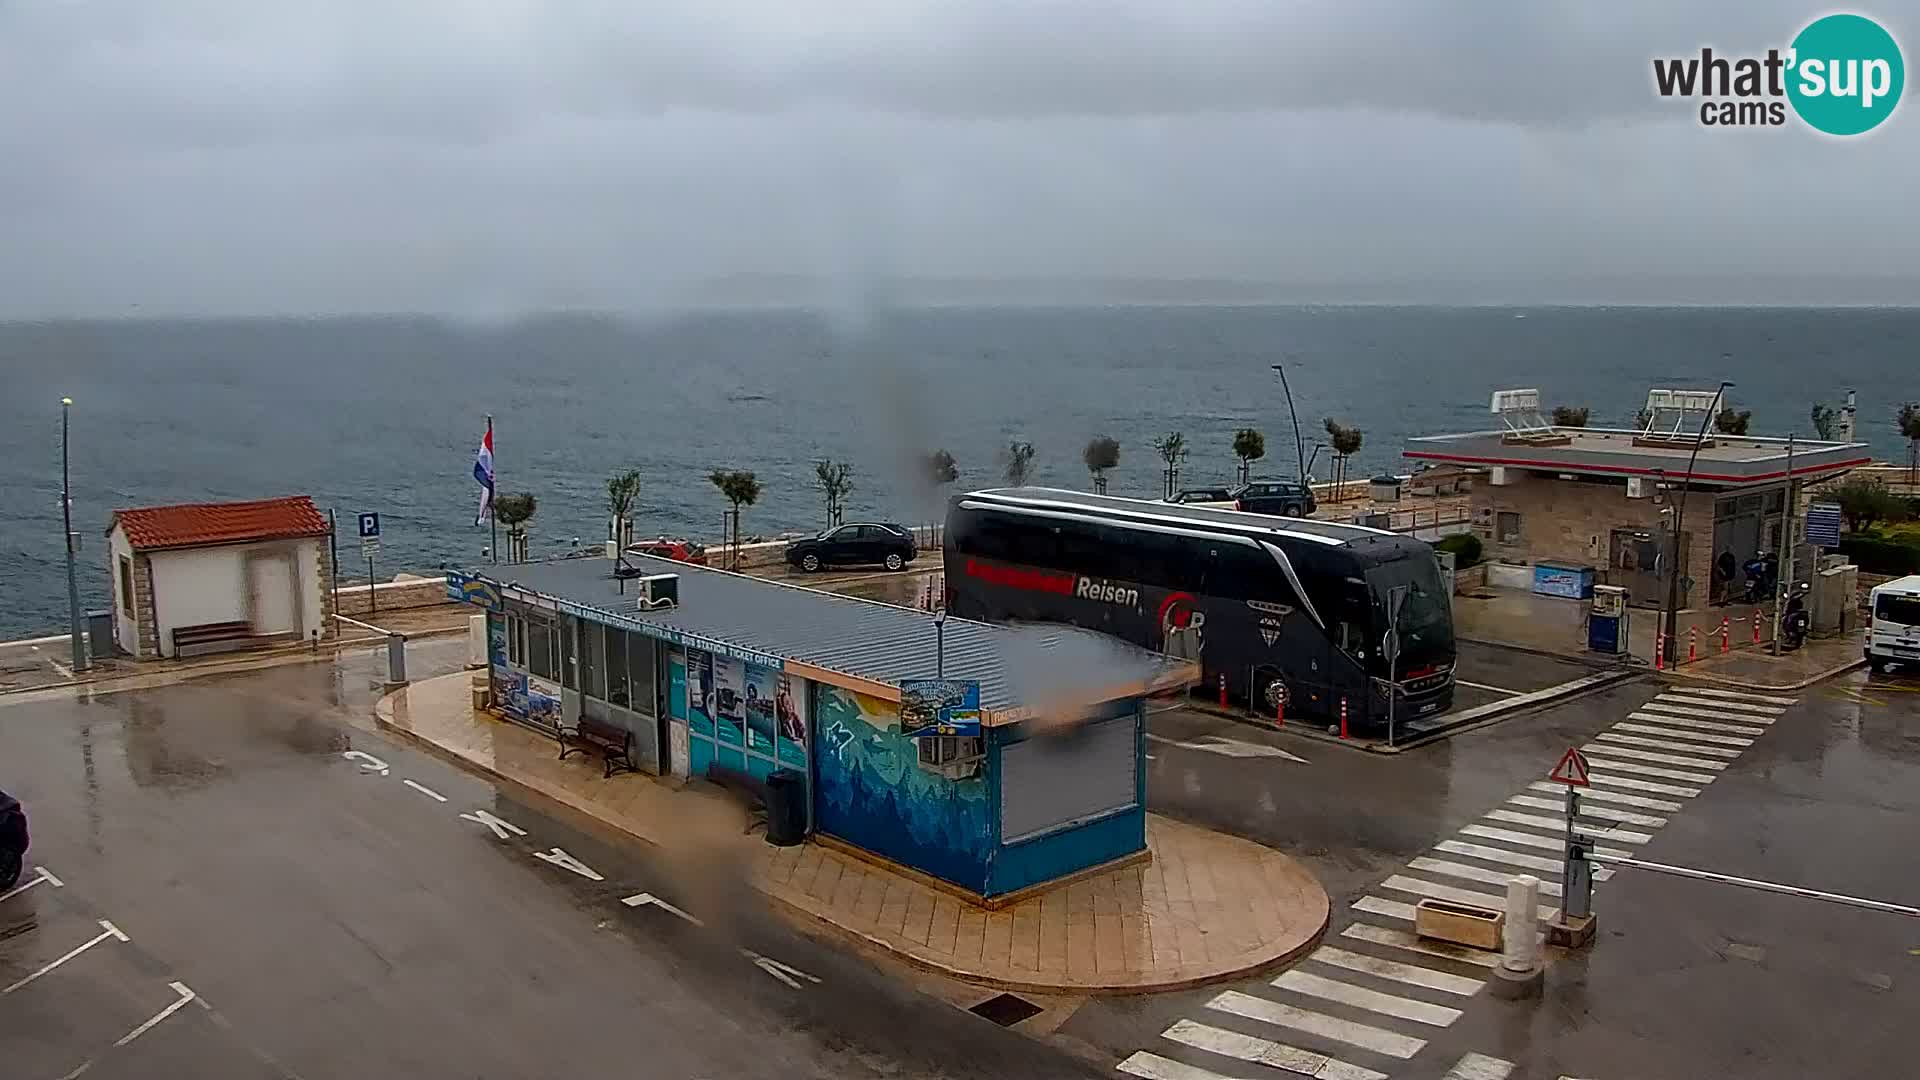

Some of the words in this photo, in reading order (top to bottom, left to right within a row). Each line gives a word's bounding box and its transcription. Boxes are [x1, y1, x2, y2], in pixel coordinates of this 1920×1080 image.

[363, 516, 375, 534] P
[1077, 576, 1138, 607] Reisen
[681, 635, 695, 648] BUS
[696, 639, 727, 655] STATION
[729, 647, 753, 662] TICKET
[754, 654, 781, 670] OFFICE
